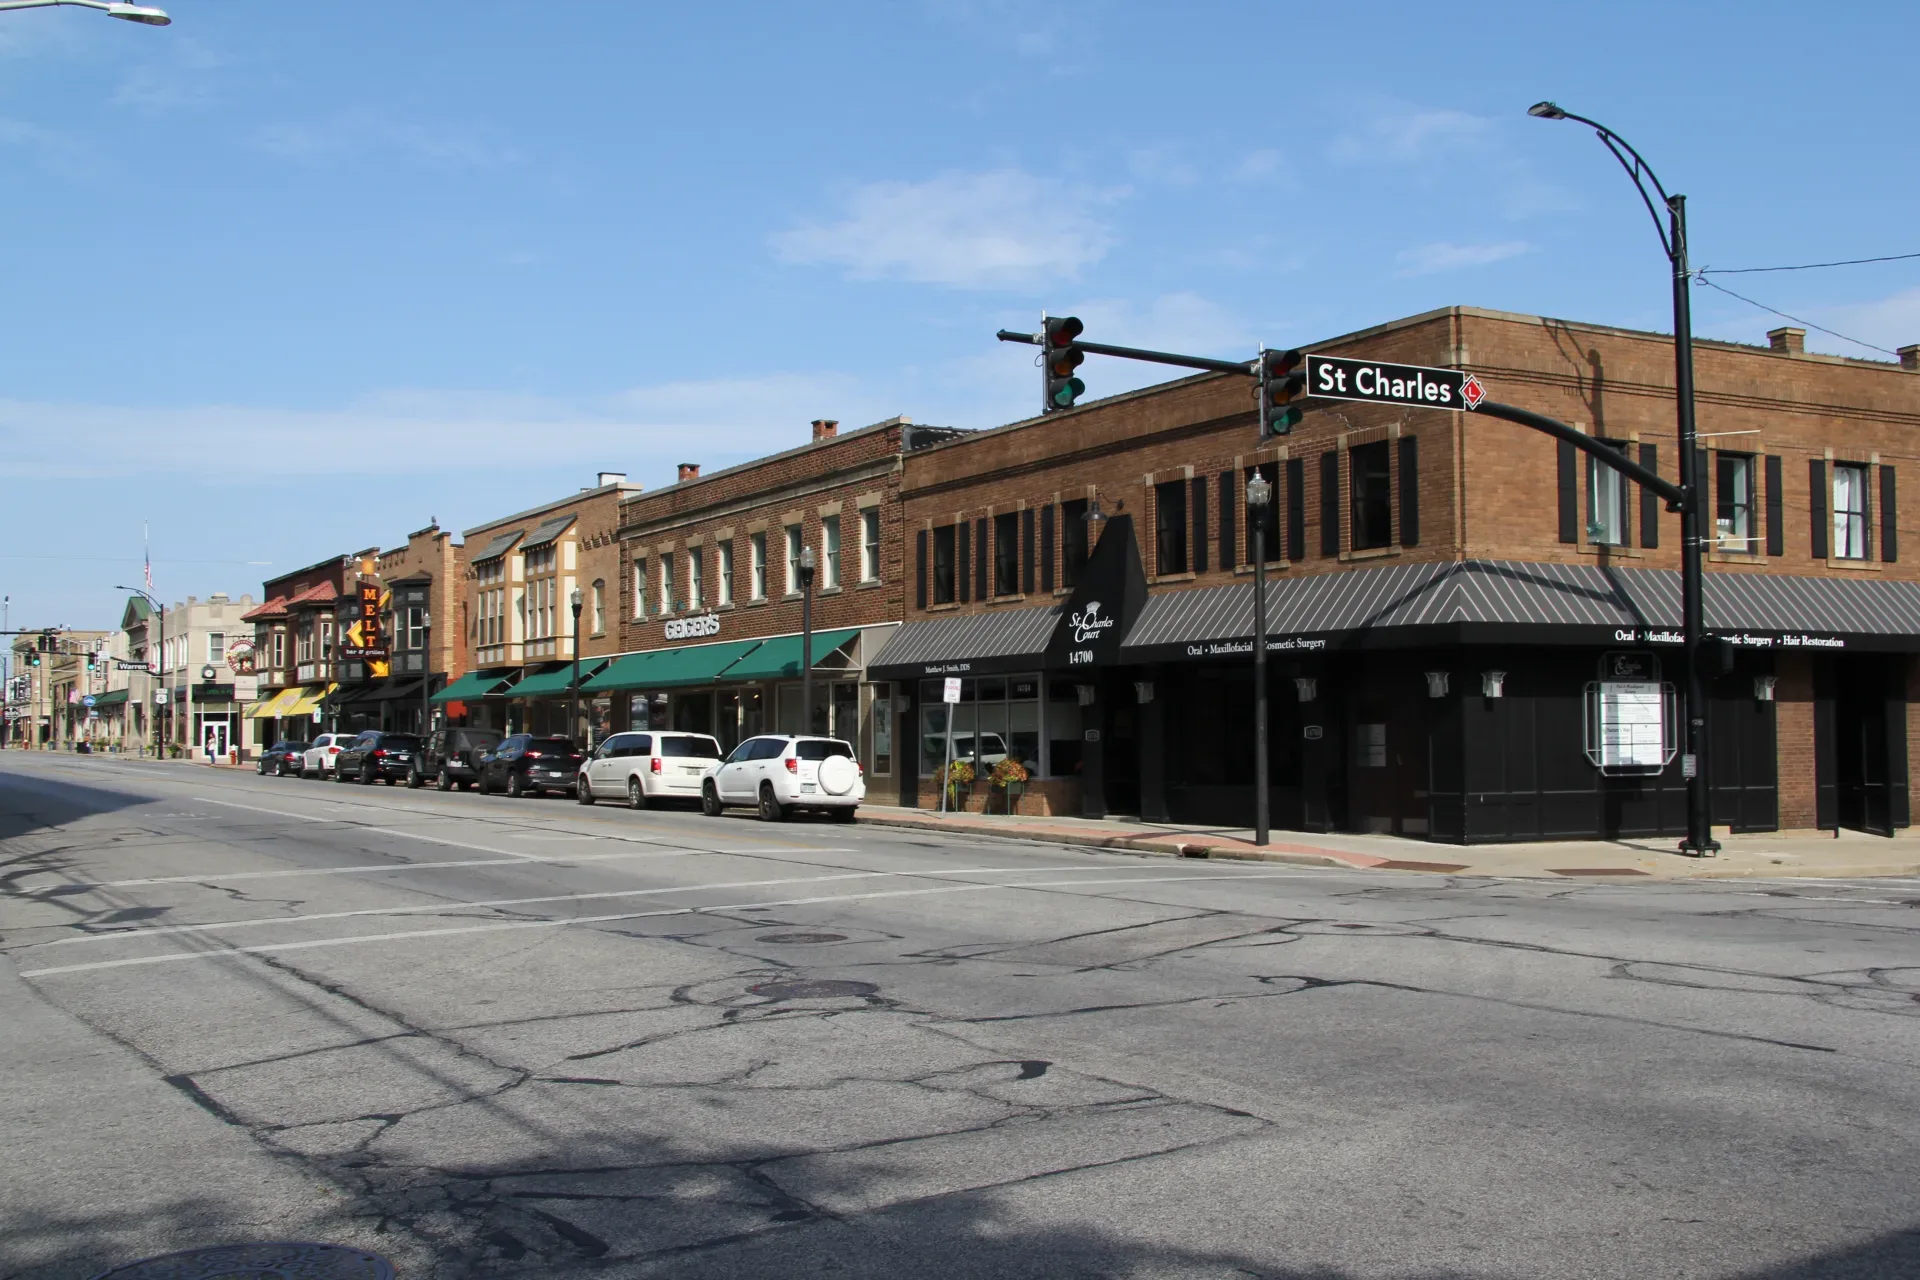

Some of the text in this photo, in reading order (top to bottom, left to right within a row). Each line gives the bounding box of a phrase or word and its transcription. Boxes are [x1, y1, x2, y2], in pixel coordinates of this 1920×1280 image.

[1318, 363, 1451, 402] St Charles
[364, 588, 377, 647] MELT
[665, 613, 720, 640] GEIGER'S
[1083, 612, 1114, 630] Charles
[1075, 624, 1100, 643] Court
[1615, 630, 1634, 641] Oral
[1644, 630, 1685, 643] Maxillofac
[1743, 633, 1772, 647] Surgery
[1783, 634, 1800, 646] Hair
[1802, 635, 1844, 647] Restoration
[1187, 637, 1326, 656] Oral Maxillofacial osmetic Surgery
[1069, 650, 1093, 664] 14700
[960, 663, 971, 672] DDS
